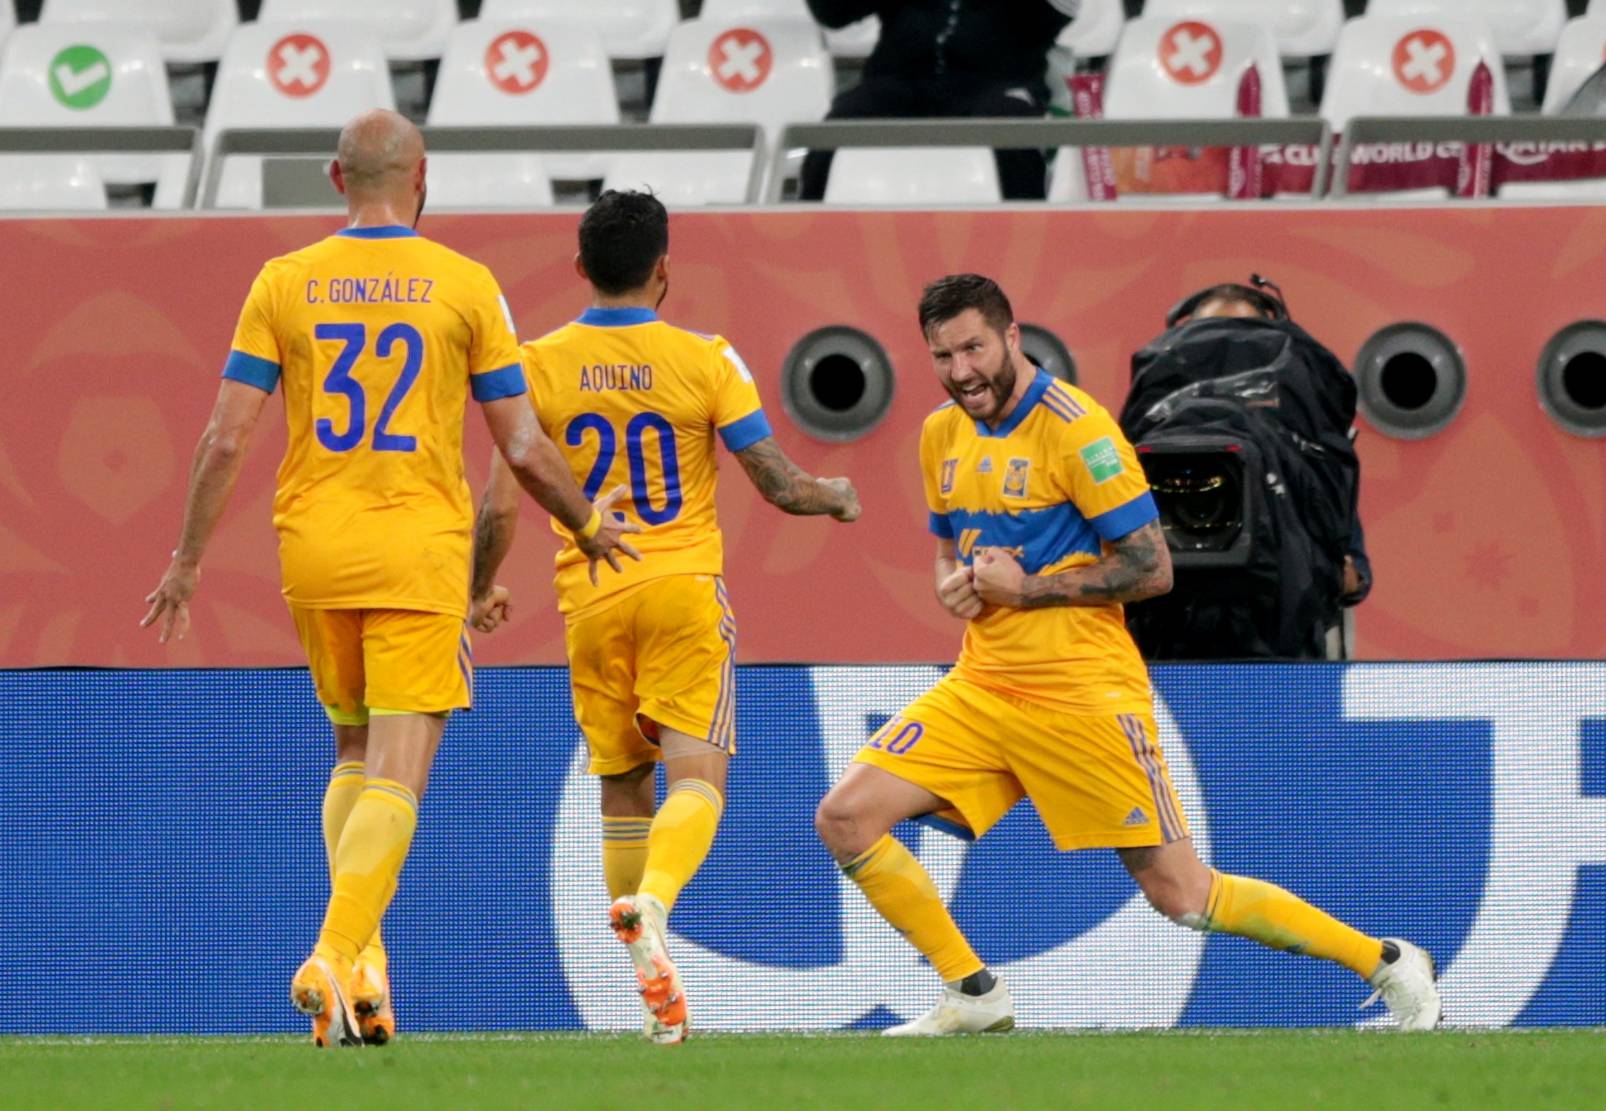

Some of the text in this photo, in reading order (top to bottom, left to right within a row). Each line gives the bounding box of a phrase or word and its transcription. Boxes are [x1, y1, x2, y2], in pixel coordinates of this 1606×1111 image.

[314, 322, 425, 453] 32
[579, 364, 653, 392] AQUINO
[565, 411, 683, 526] 20
